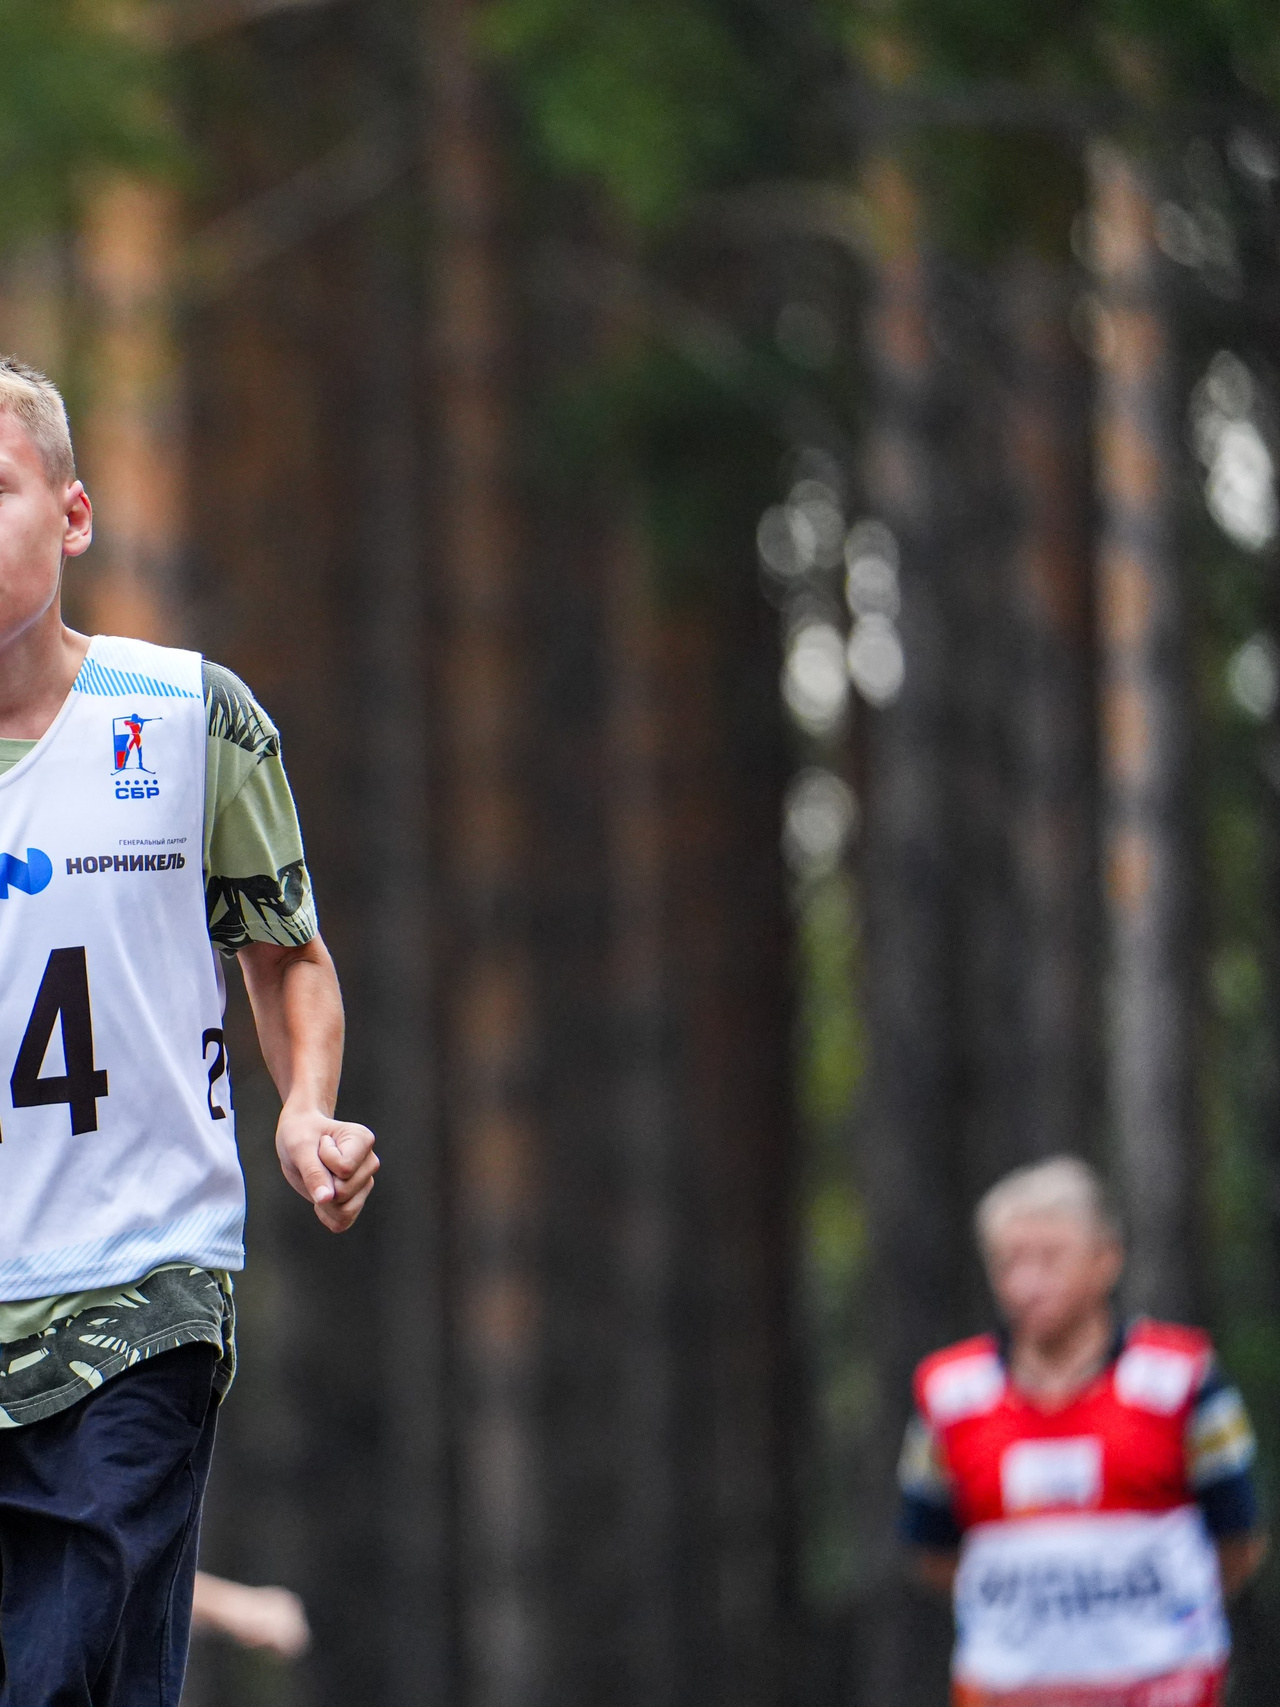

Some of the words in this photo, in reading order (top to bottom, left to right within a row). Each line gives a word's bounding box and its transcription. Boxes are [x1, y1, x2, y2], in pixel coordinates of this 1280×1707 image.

[115, 787, 160, 800] СБР
[119, 838, 165, 846] ГЕНЕРАЛЬНЫЙ
[166, 837, 187, 845] ПАРТНЕР
[66, 853, 186, 875] НОРНИКЕЛЬ
